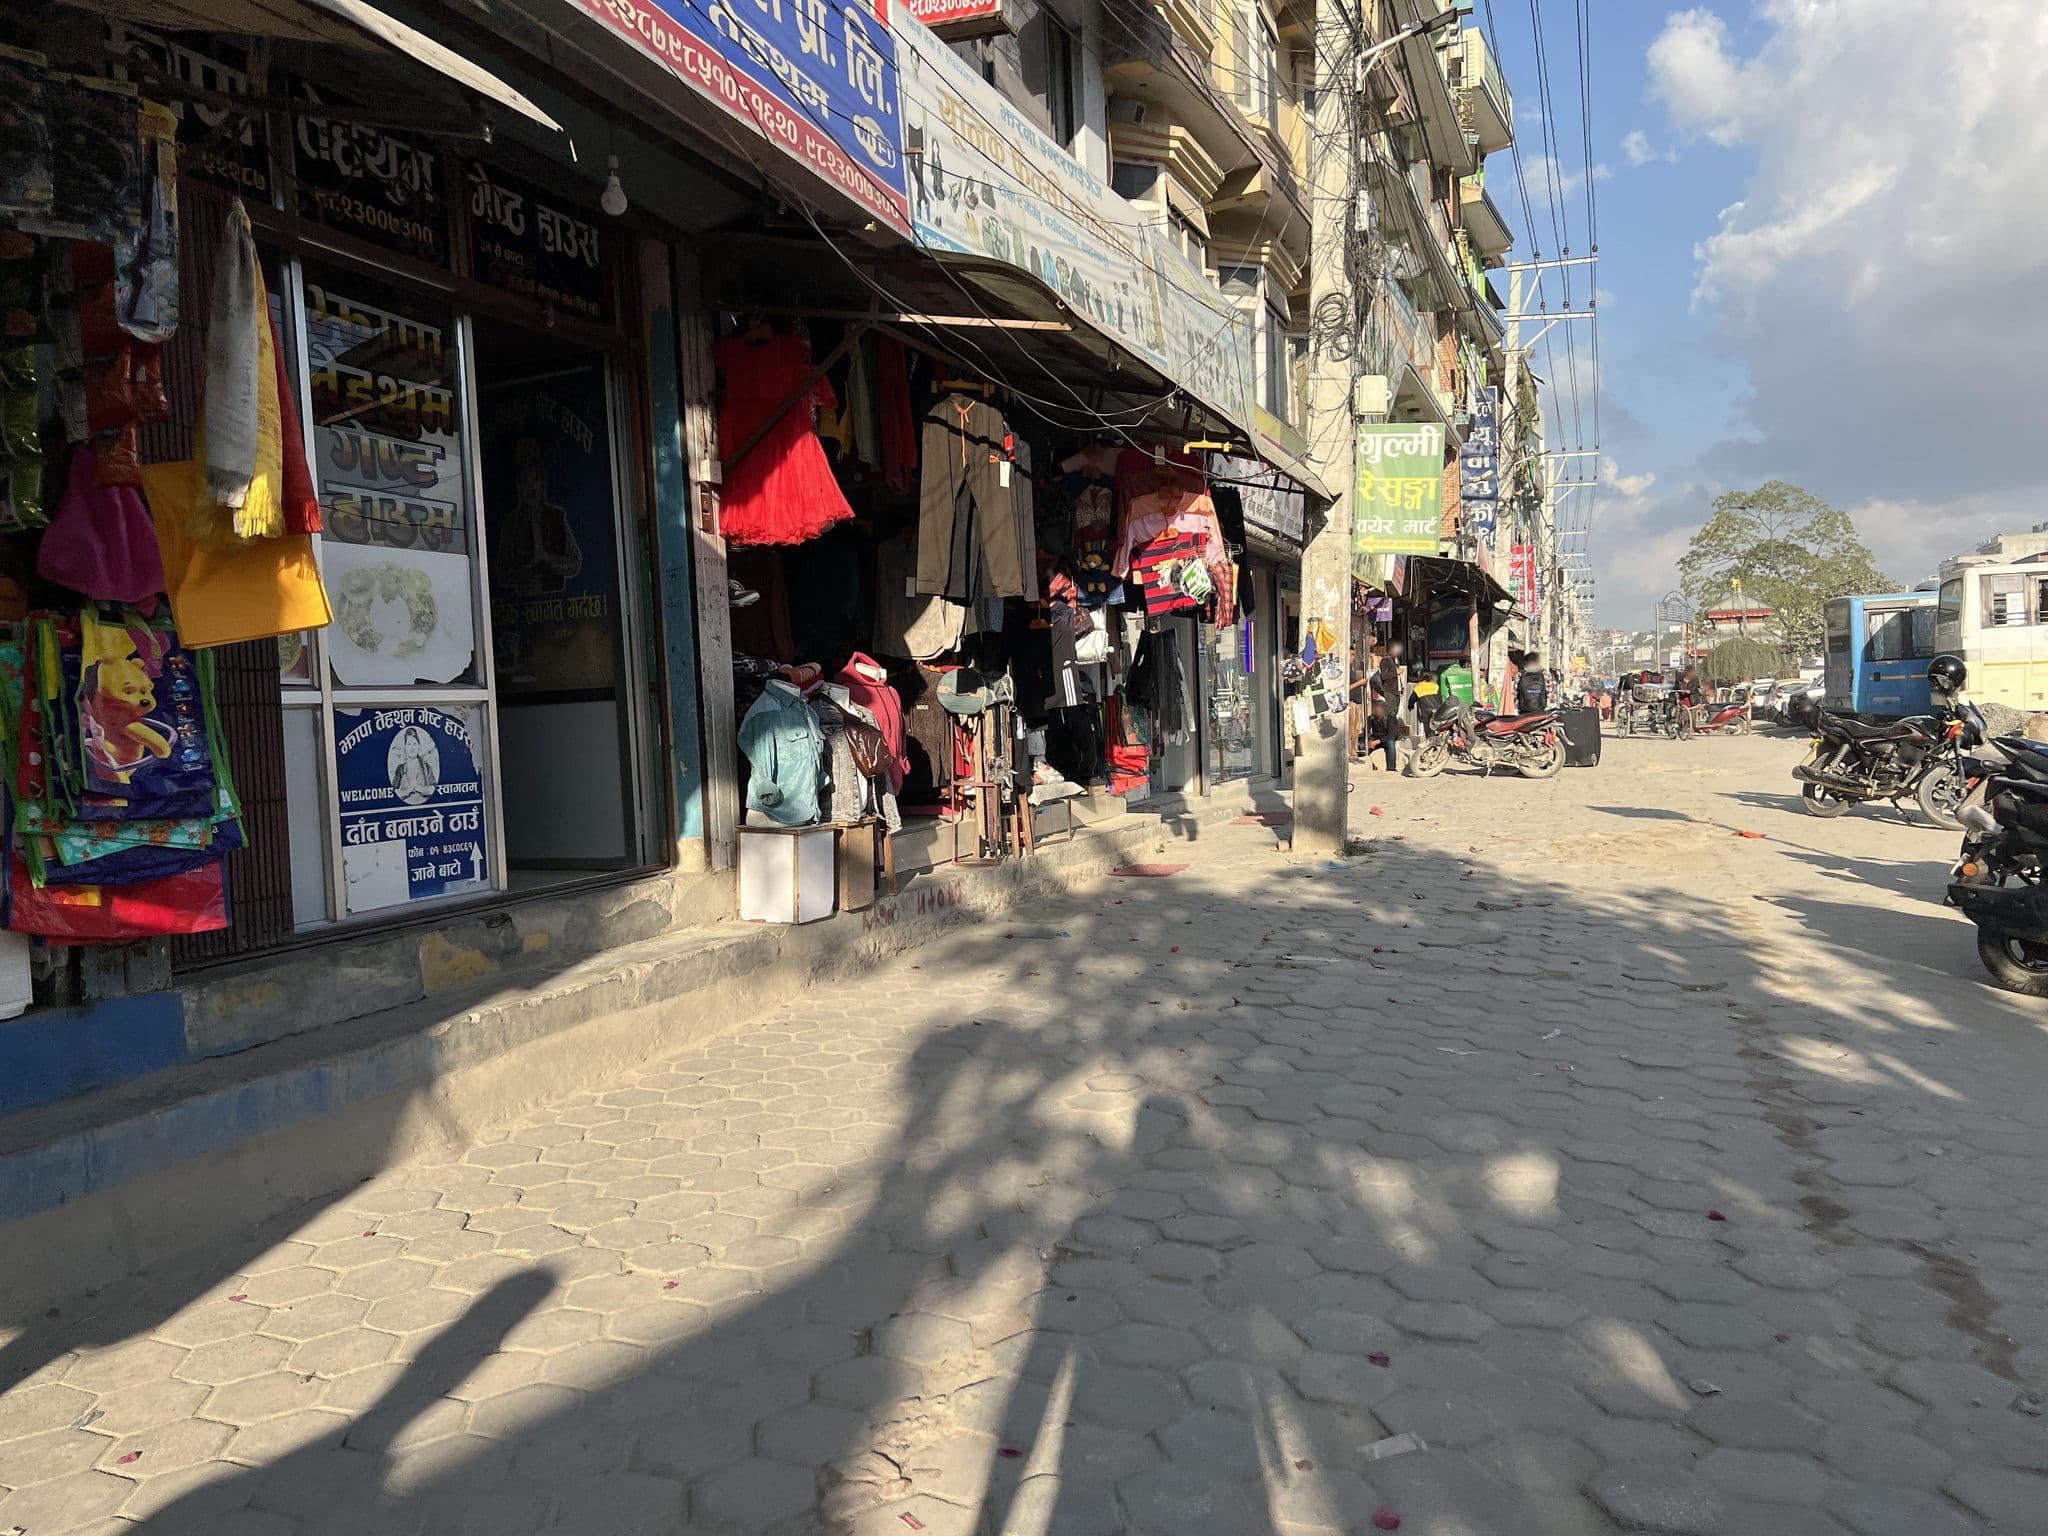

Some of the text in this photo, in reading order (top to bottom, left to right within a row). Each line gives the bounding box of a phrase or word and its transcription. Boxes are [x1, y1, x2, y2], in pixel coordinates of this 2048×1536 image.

[1358, 425, 1442, 464] गुल्मी
[1403, 516, 1438, 534] मार्ट
[339, 719, 372, 754] झापा
[341, 786, 394, 802] WELCOME
[436, 782, 479, 797] स्वागतम्
[345, 806, 480, 846] दाँत बनाउने ठाउँ
[411, 858, 461, 882] जाने बाटो
